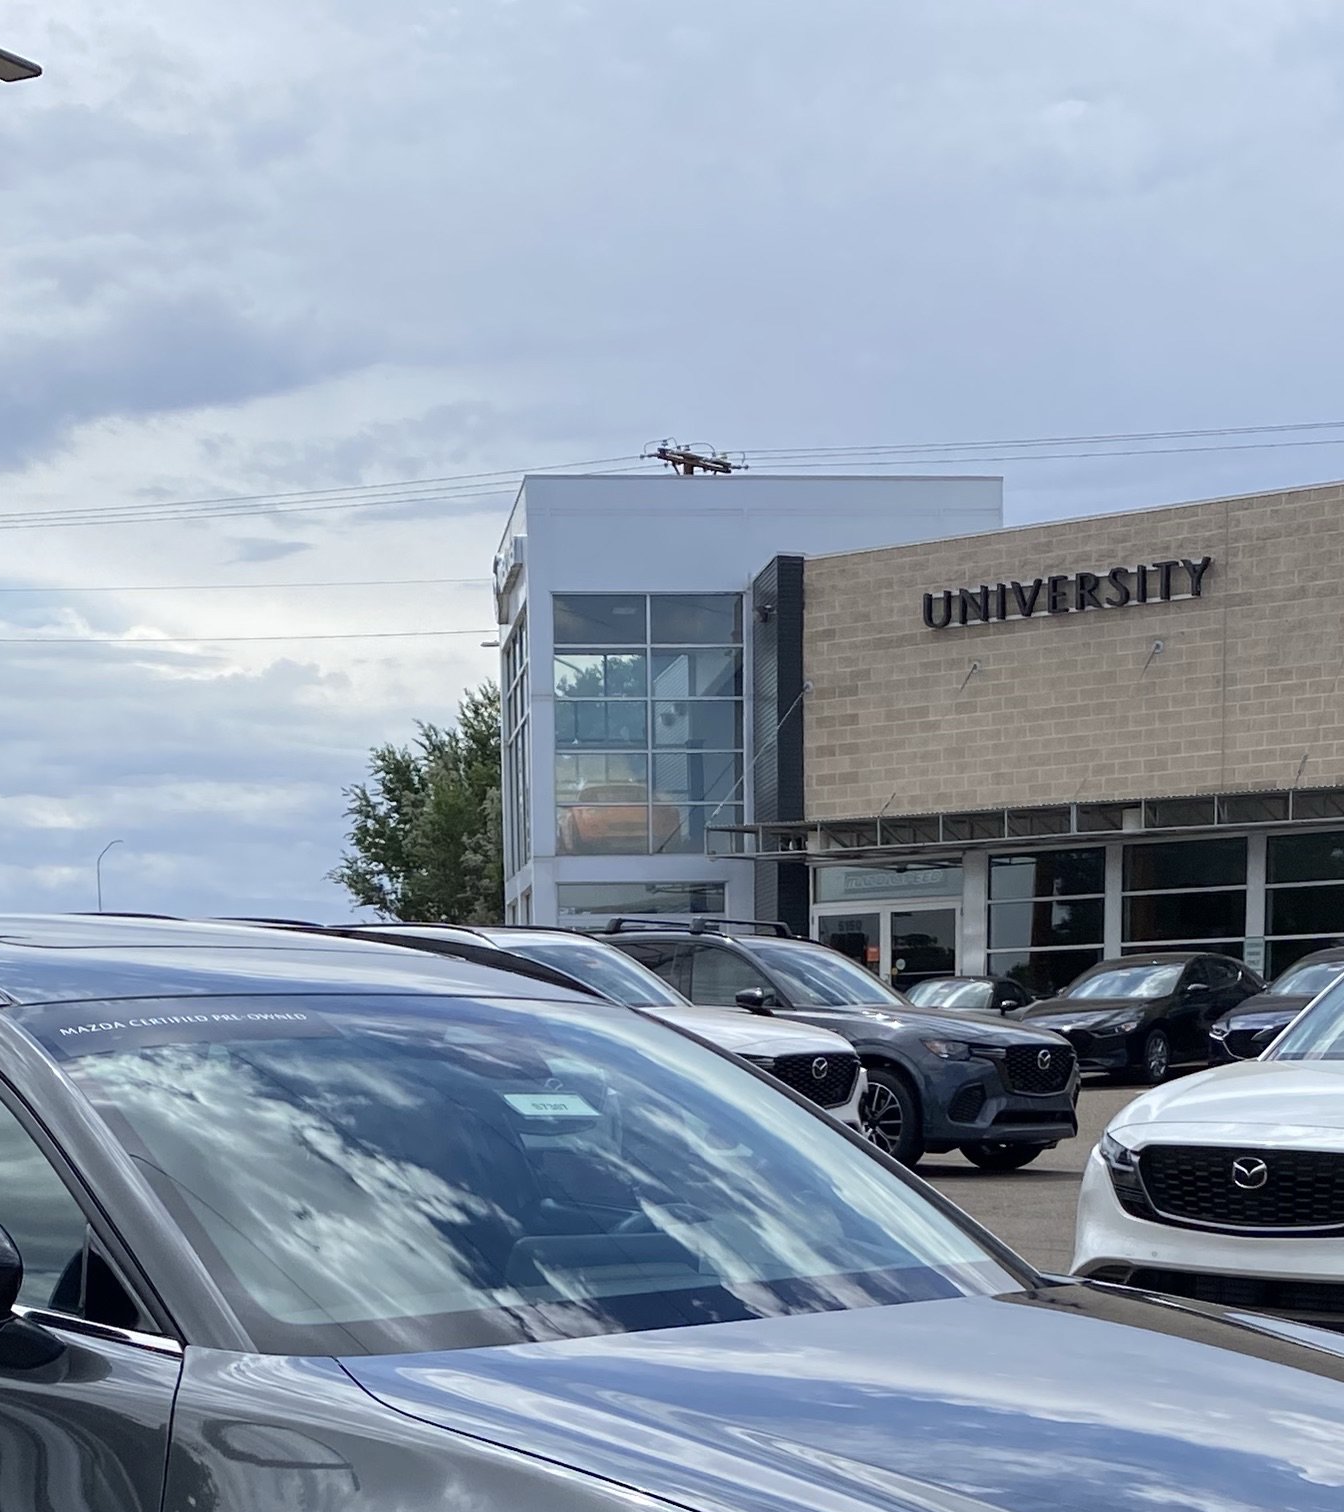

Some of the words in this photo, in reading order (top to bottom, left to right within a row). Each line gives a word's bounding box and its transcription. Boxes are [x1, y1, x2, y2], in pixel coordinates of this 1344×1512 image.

[922, 555, 1213, 629] UNIVERSITY
[59, 1021, 127, 1036] MAZDA
[128, 1015, 208, 1028] CERTIFIED
[211, 1012, 307, 1022] PRE-OWNED
